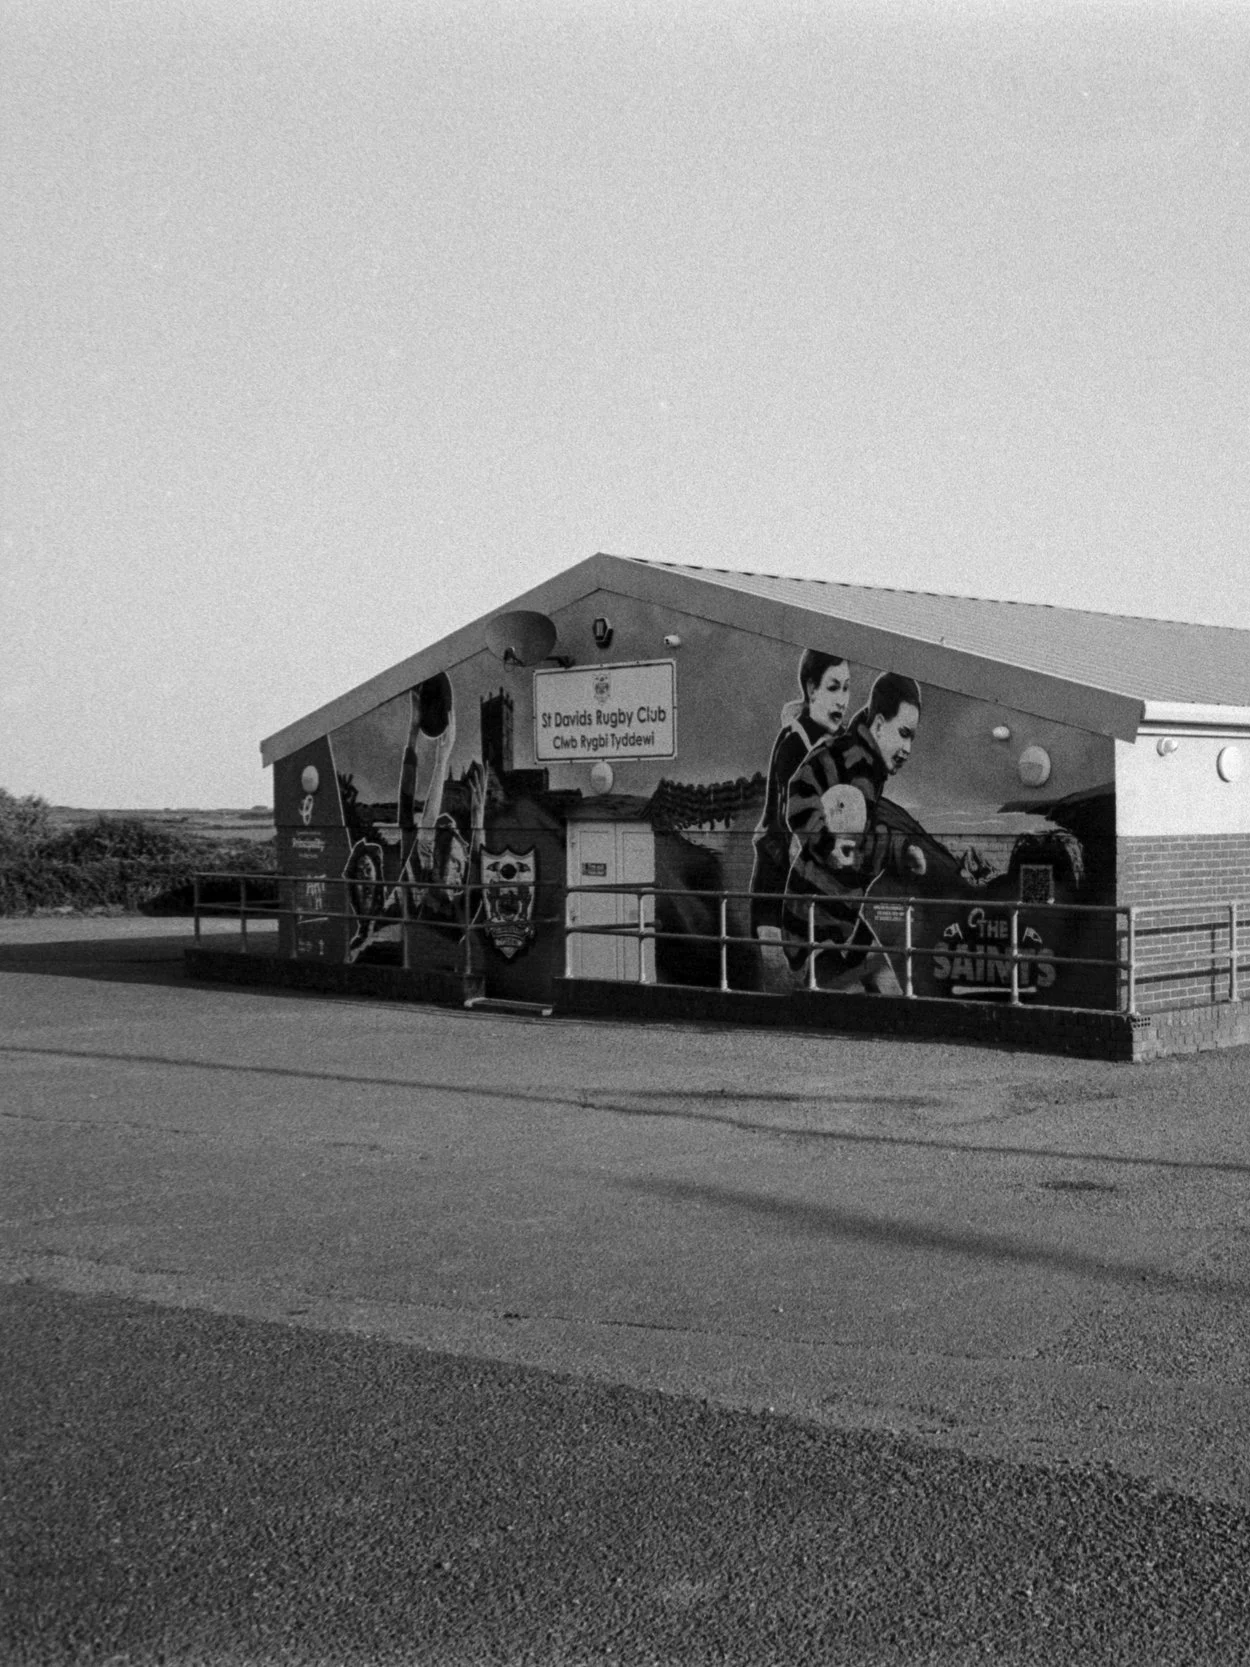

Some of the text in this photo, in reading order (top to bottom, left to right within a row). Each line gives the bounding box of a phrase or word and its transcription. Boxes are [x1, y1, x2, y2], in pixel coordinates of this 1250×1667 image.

[541, 706, 667, 728] St Davids Rugby Club
[553, 731, 655, 751] Clwb Rygbi Tyddewi
[977, 918, 1009, 939] THE
[932, 942, 1056, 987] SAINTS
